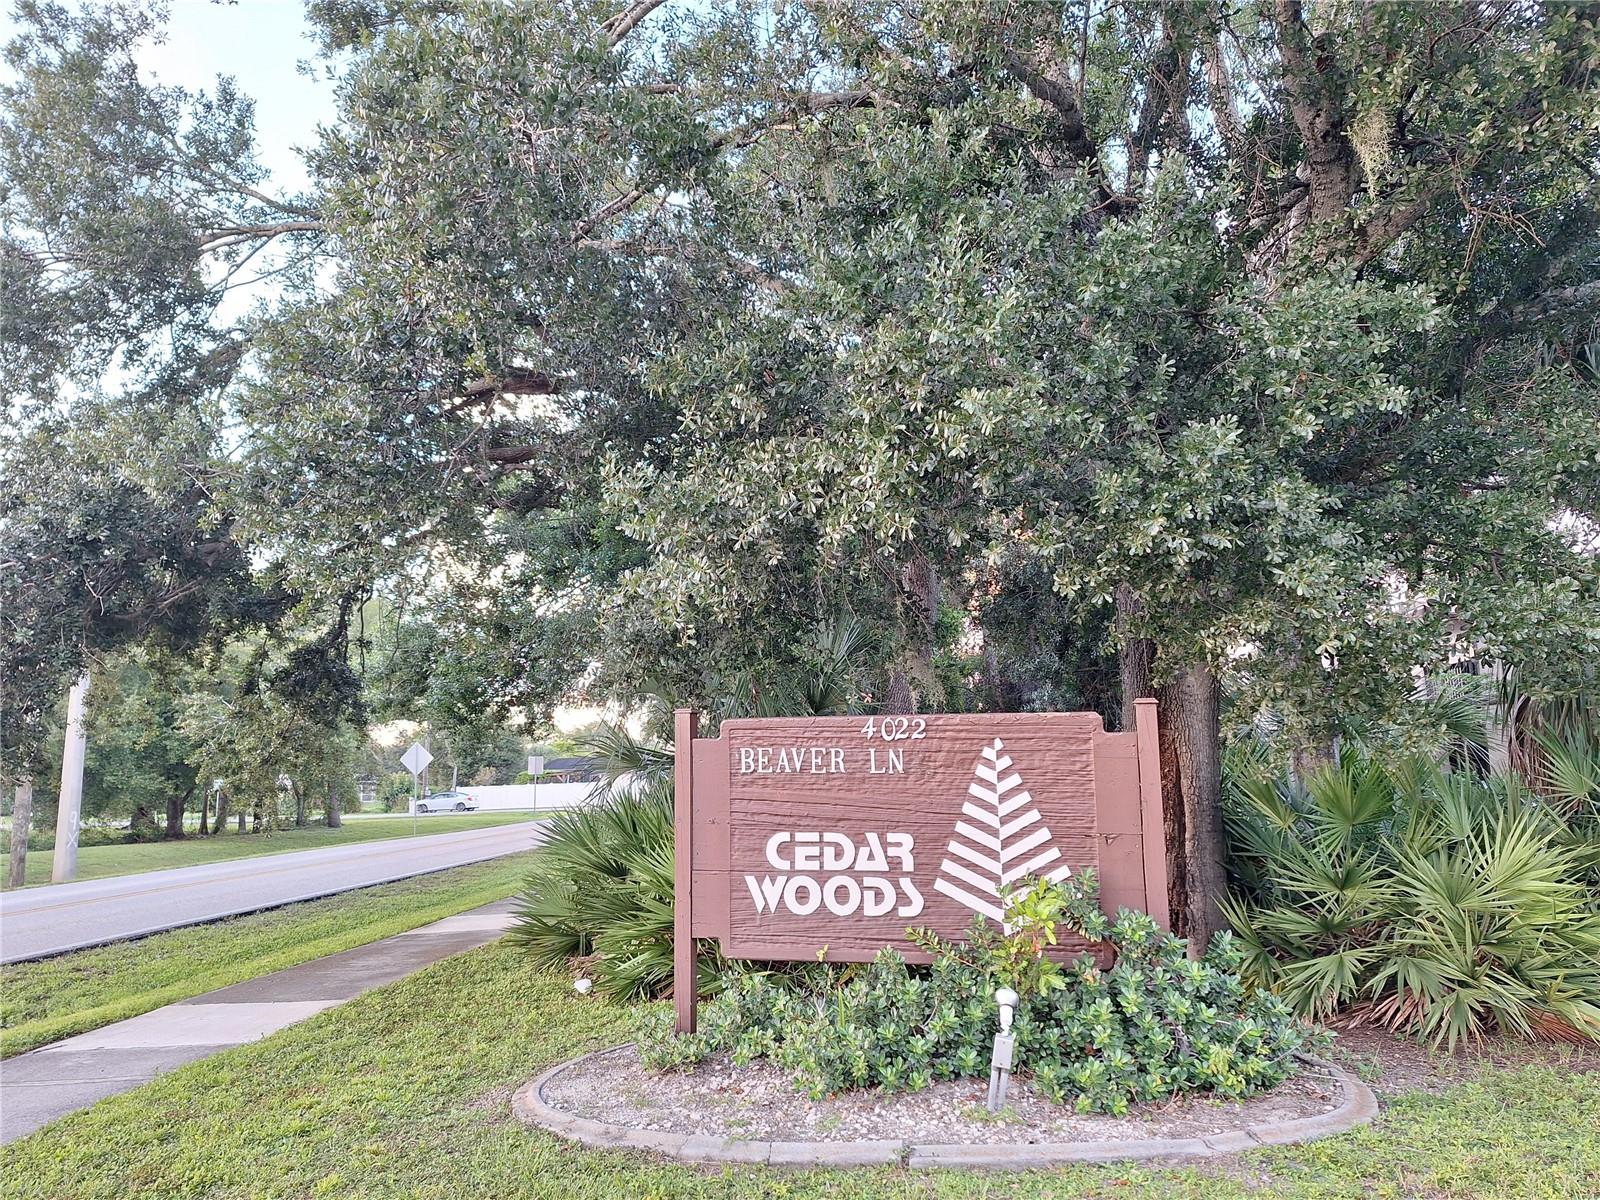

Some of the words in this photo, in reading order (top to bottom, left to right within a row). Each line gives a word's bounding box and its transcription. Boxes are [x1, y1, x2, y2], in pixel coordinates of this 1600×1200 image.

[861, 716, 927, 741] 4022
[739, 747, 846, 774] BEAVER
[869, 748, 905, 774] LN
[765, 832, 914, 872] CEDAR
[744, 875, 924, 917] WOODS
